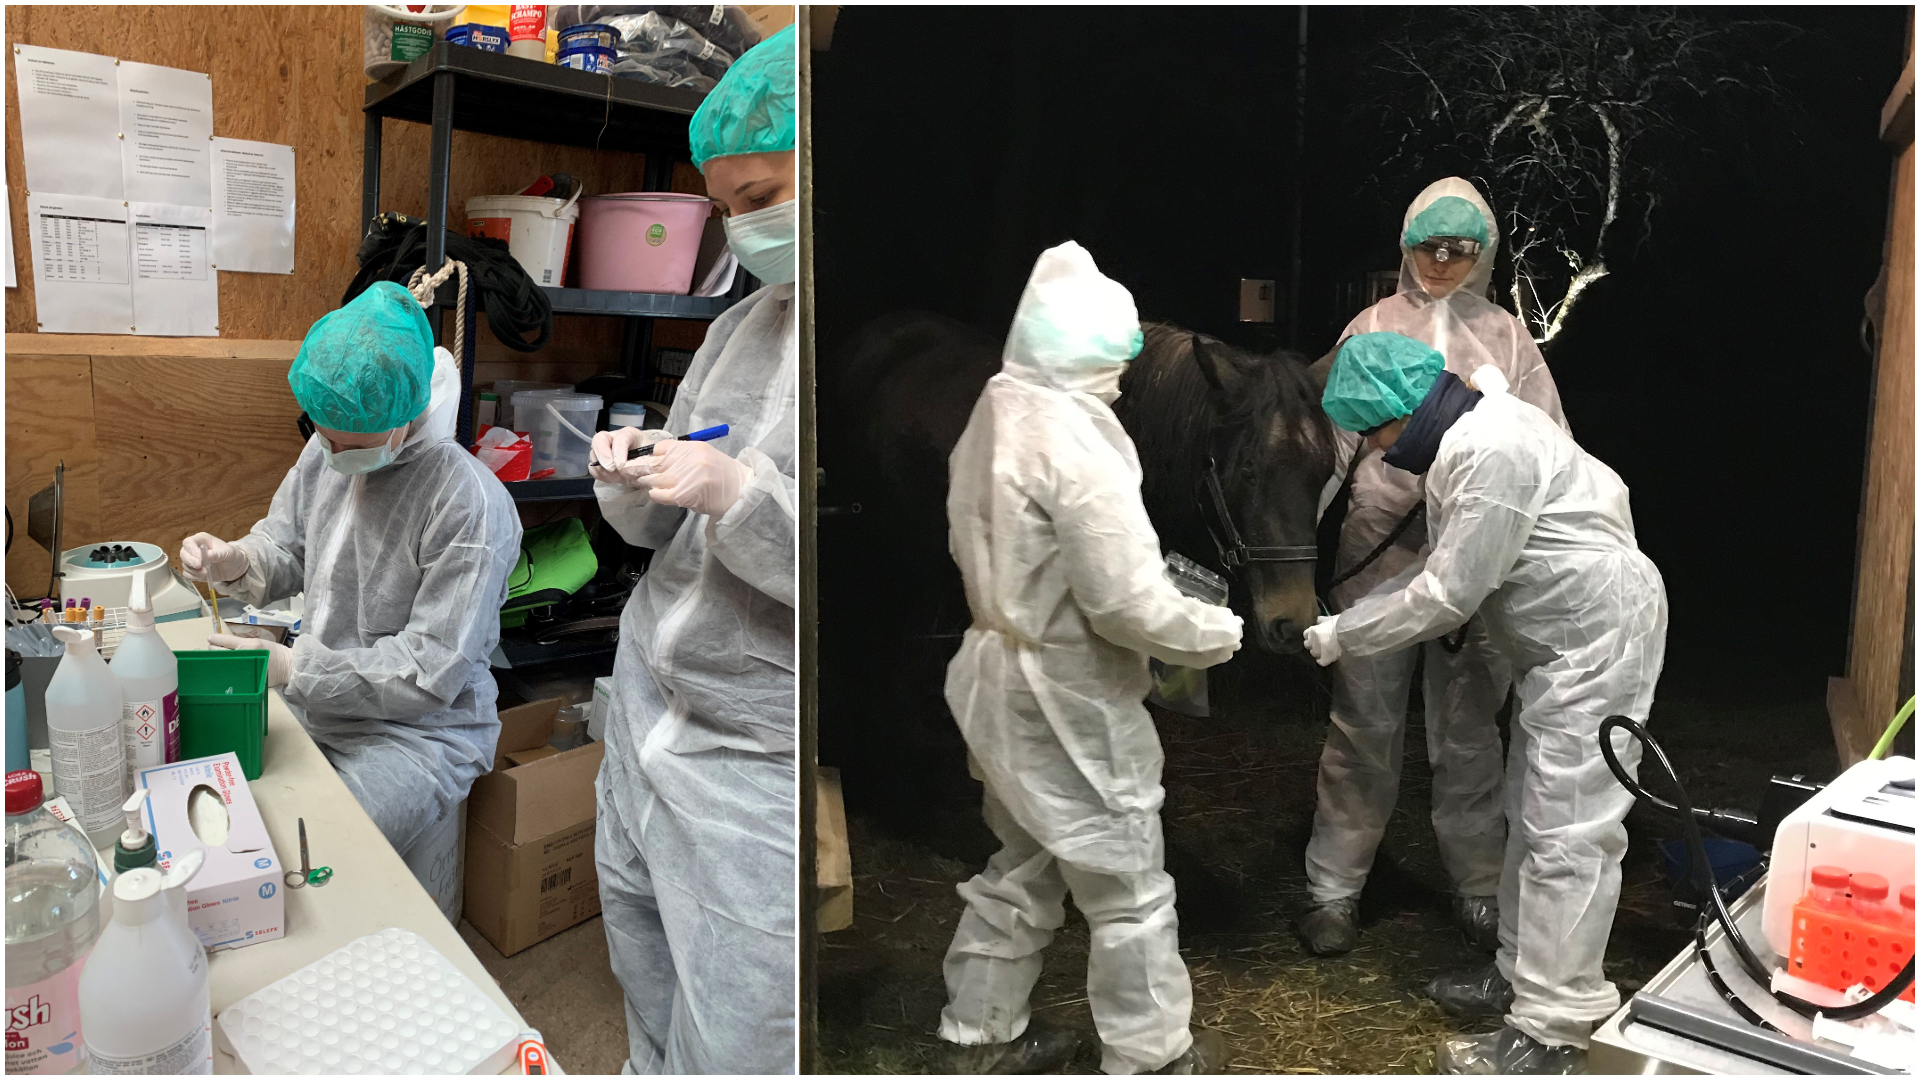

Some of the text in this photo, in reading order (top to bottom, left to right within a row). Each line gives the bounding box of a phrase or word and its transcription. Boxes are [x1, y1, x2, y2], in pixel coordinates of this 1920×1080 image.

[394, 25, 432, 36] HÄSTGODIS
[262, 884, 274, 897] M
[202, 901, 220, 909] Gloves
[222, 896, 240, 904] Nitrile
[255, 926, 278, 936] SELEFA
